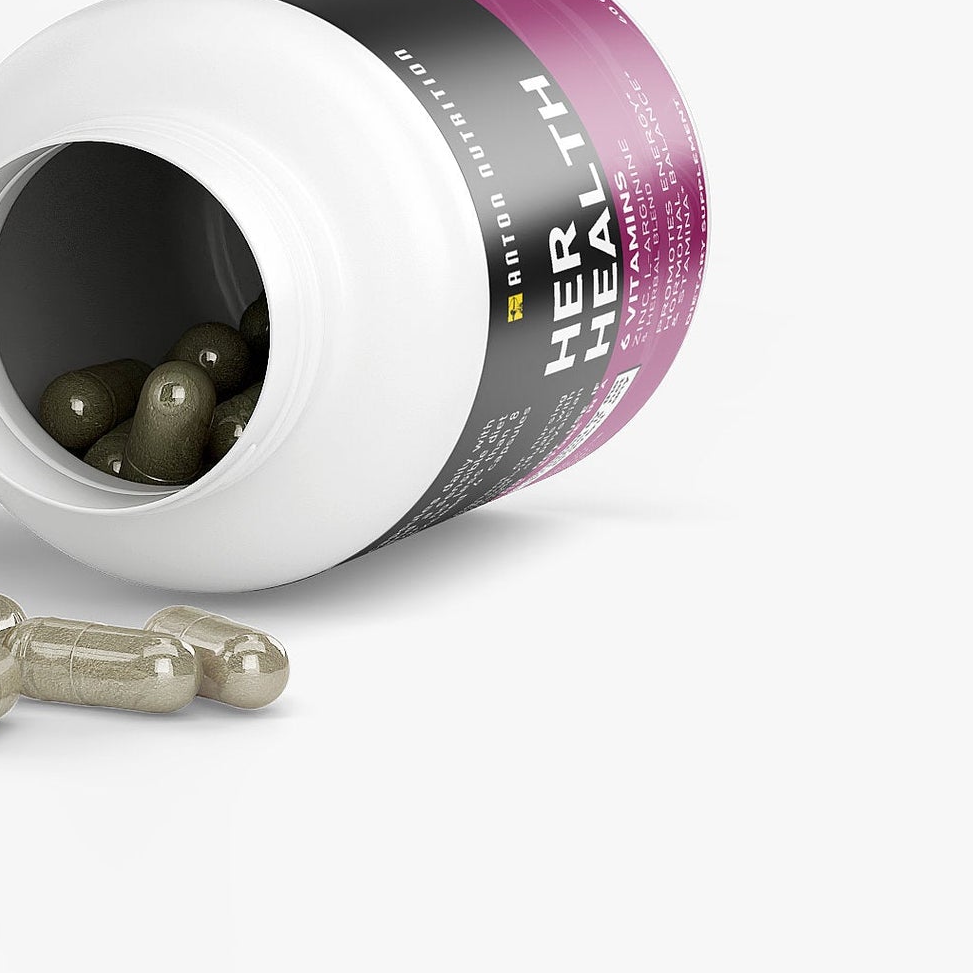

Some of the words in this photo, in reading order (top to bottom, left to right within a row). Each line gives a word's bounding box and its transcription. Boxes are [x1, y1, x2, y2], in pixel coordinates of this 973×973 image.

[393, 48, 494, 178] NUTRITION
[491, 193, 522, 287] ANTON
[518, 75, 618, 363] HEALTH
[614, 171, 640, 326] VITAMINS
[617, 138, 652, 278] L-ARGININE
[645, 183, 660, 245] BLEND
[655, 200, 674, 333] PROMOTES
[543, 221, 583, 377] HER
[620, 333, 631, 351] 6
